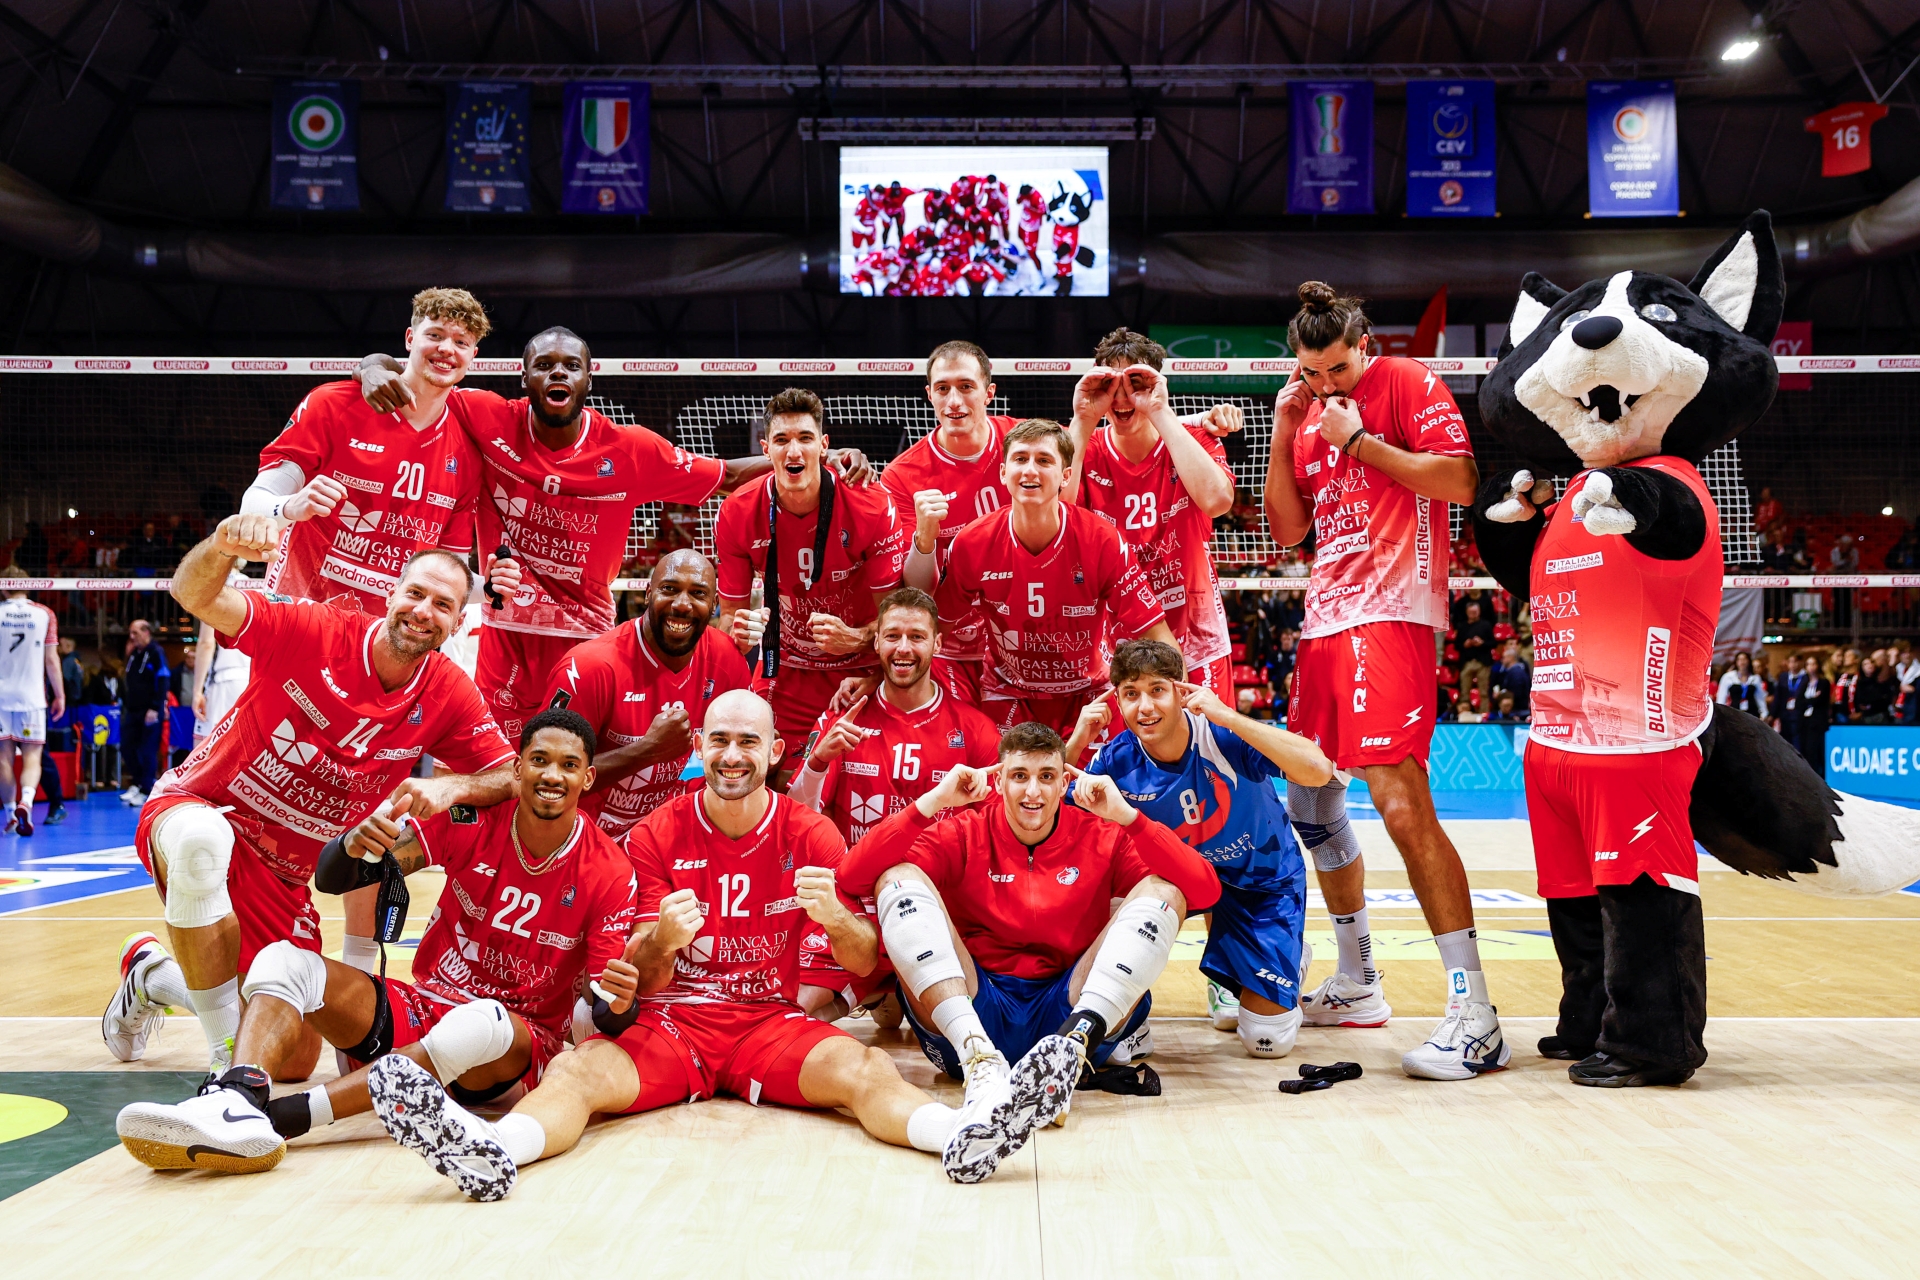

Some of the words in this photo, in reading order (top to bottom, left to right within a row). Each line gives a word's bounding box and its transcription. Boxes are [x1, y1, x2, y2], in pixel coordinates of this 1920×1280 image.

[1435, 140, 1466, 154] CEV
[1832, 125, 1860, 151] 16
[78, 360, 129, 369] BLUENERGY
[156, 361, 208, 370] BLUENERGY
[234, 361, 286, 370] BLUENERGY
[625, 362, 676, 371] BLUENERGY
[703, 362, 755, 371] BLUENERGY
[782, 362, 834, 371] BLUENERGY
[860, 362, 912, 371] BLUENERGY
[1017, 362, 1069, 371] BLUENERGY
[1174, 362, 1226, 371] BLUENERGY
[1801, 359, 1854, 368] BLUENERGY
[1413, 402, 1451, 423] IVECO
[1420, 415, 1447, 434] ARA
[349, 438, 385, 453] Zeus
[490, 437, 522, 463] Zeus
[343, 475, 383, 490] ITALIANA
[392, 460, 425, 501] 20
[1087, 470, 1114, 487] Zeus
[1349, 466, 1366, 482] DI
[542, 475, 561, 496] 6
[531, 502, 579, 524] BANCA
[583, 513, 599, 525] DI
[1124, 491, 1158, 530] 23
[385, 512, 427, 532] BANCA
[430, 522, 442, 534] DI
[529, 513, 598, 535] PIACENZA
[381, 524, 440, 545] PIACENZA
[522, 527, 548, 544] GAS
[551, 537, 591, 552] SALES
[1417, 494, 1430, 580] BLUENERGY
[371, 541, 400, 558] GAS
[520, 537, 587, 564] ENERGIA
[798, 548, 815, 583] 9
[1151, 558, 1182, 579] SALES
[1556, 553, 1601, 566] ITALIANA
[1556, 560, 1601, 572] ASSICURAZIONI
[79, 580, 131, 588] BLUENERGY
[980, 570, 1014, 582] Zeus
[1736, 578, 1788, 586] BLUENERGY
[1814, 578, 1866, 586] BLUENERGY
[514, 589, 536, 600] BFT
[1027, 583, 1045, 617] 5
[1319, 584, 1362, 601] BURZONI
[1558, 590, 1577, 604] DI
[9, 632, 25, 653] 7
[1023, 631, 1070, 644] BANCA
[1076, 629, 1091, 641] DI
[1024, 638, 1093, 653] PIACENZA
[1538, 629, 1575, 646] SALES
[1020, 658, 1049, 670] GAS
[1053, 655, 1090, 669] SALES
[1022, 665, 1089, 679] ENERGIA
[320, 667, 349, 699] Zeus
[1000, 663, 1091, 694] nordmeccanica
[1647, 633, 1666, 734] BLUENERGY
[294, 686, 328, 725] ITALIANA
[337, 717, 384, 758] 14
[1360, 736, 1391, 747] Zeus
[318, 754, 370, 784] BANCA
[371, 774, 390, 785] DI
[892, 743, 922, 781] 15
[1830, 746, 1895, 776] CALDAIE
[1897, 747, 1908, 776] E
[311, 764, 382, 795] PIACENZA
[292, 778, 326, 801] GAS
[324, 795, 369, 814] SALES
[1120, 789, 1157, 802] Zeus
[233, 778, 341, 839] nordmeccanica
[284, 789, 358, 823] ENERGIA
[1179, 789, 1200, 825] 8
[1215, 831, 1251, 857] SALES
[472, 862, 498, 877] Ze
[718, 873, 751, 918] 12
[491, 885, 542, 939] 22
[899, 907, 917, 918] errea
[384, 906, 399, 941] OVERTRAQ
[602, 922, 630, 933] ARA
[719, 935, 767, 949] BANCA
[773, 930, 788, 944] DI
[1137, 927, 1156, 943] errea
[483, 946, 538, 976] BANCA
[542, 966, 558, 979] DI
[717, 944, 786, 963] PIACENZA
[482, 959, 555, 989] PIACENZA
[1255, 967, 1294, 989] Zeus
[471, 975, 498, 996] GAS
